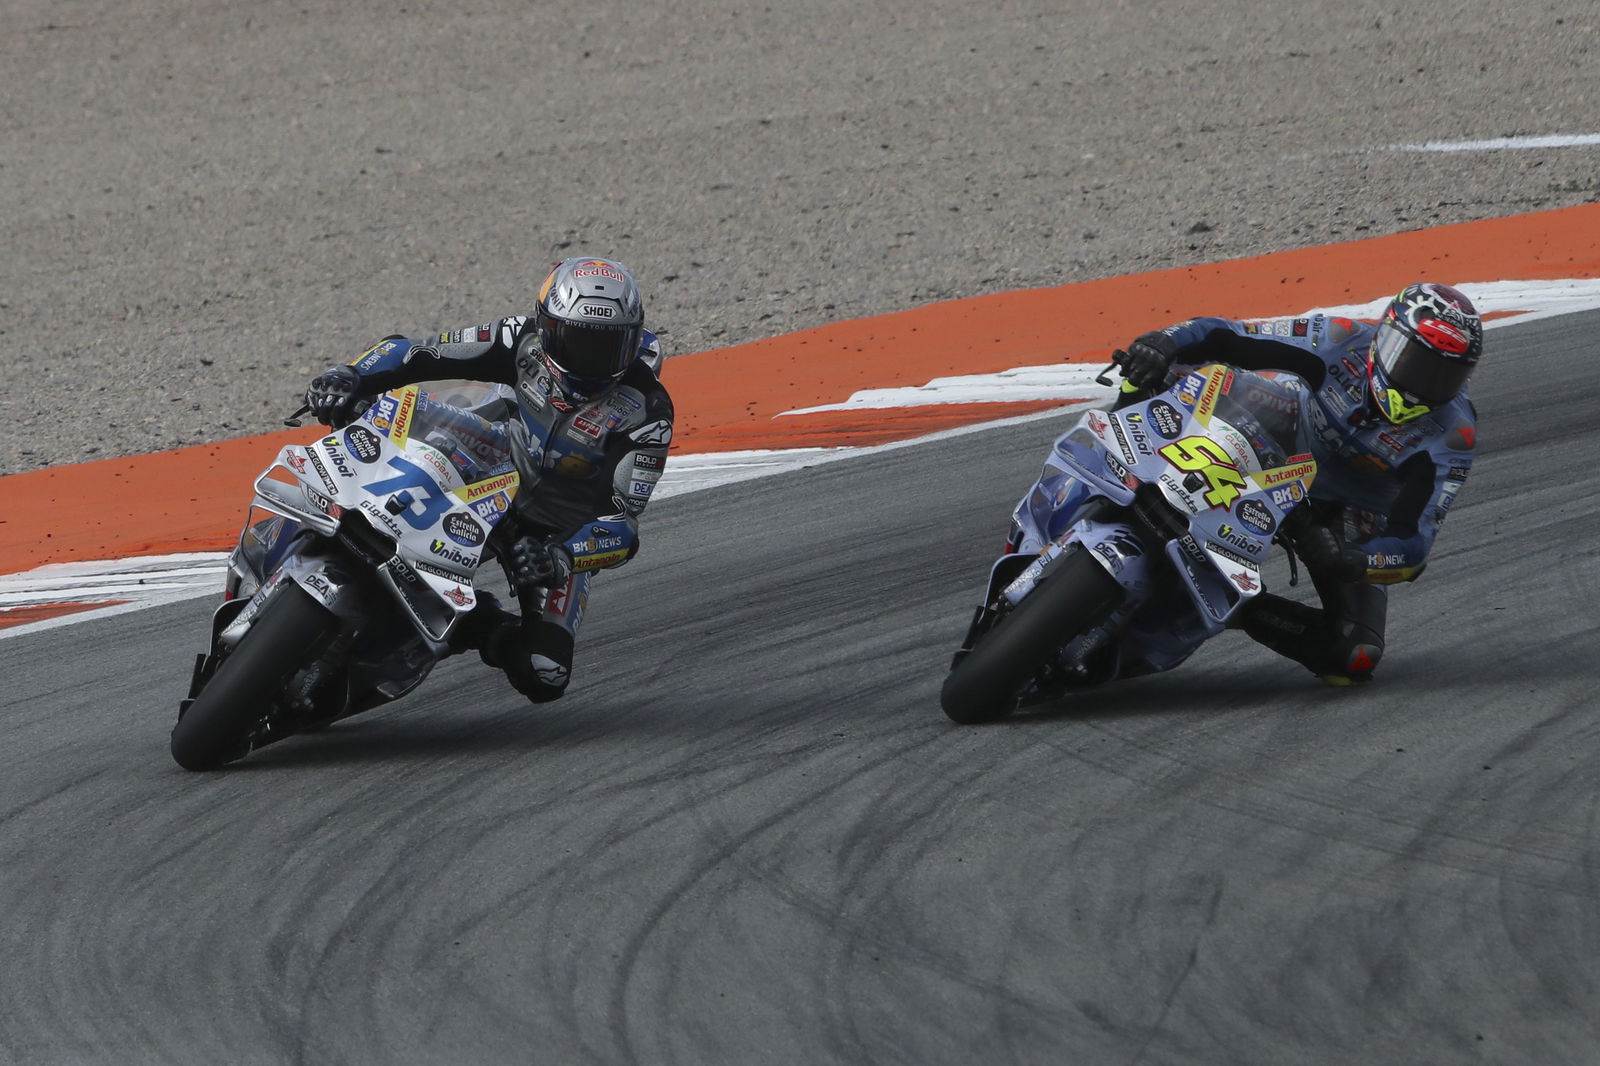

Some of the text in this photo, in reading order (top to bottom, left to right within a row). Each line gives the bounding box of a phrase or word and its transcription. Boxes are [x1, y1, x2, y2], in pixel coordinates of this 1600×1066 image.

[574, 268, 625, 282] Red Bull
[583, 305, 613, 318] SHOEI
[590, 323, 606, 331] YOU
[1423, 320, 1467, 344] LS2
[360, 349, 381, 370] NEWS
[1178, 375, 1202, 406] BK8
[1199, 368, 1224, 415] Antangin
[371, 399, 394, 431] BK8
[394, 389, 416, 439] Antangin
[1152, 407, 1169, 434] Galicia
[1161, 405, 1178, 433] Estrella
[349, 432, 368, 459] Galicia
[357, 430, 377, 457] Estrella
[1126, 412, 1152, 456] Unibat
[1231, 430, 1249, 448] AUS
[322, 436, 354, 478] Unibat
[430, 449, 449, 465] AUS
[636, 454, 657, 465] BOLD
[1225, 434, 1250, 468] GLOBAL
[424, 453, 452, 484] GLOBAL
[1157, 435, 1248, 513] 54
[1264, 464, 1313, 485] Antangin
[308, 488, 328, 508] BOLD
[361, 455, 454, 531] 73
[467, 474, 515, 499] Antangin
[1160, 473, 1198, 514] Gigetta
[1272, 483, 1303, 505] BK8
[476, 493, 508, 518] BK8
[1243, 503, 1271, 524] Estrella
[360, 500, 403, 539] Gigetta
[449, 525, 477, 541] Galicia
[450, 516, 480, 535] Estrella
[1242, 512, 1268, 530] Galicia
[572, 536, 622, 553] BK8 NEWS
[1183, 534, 1206, 562] BOLD
[1217, 523, 1263, 556] Unibat
[429, 539, 478, 569] Unibat
[389, 555, 416, 582] BOLD
